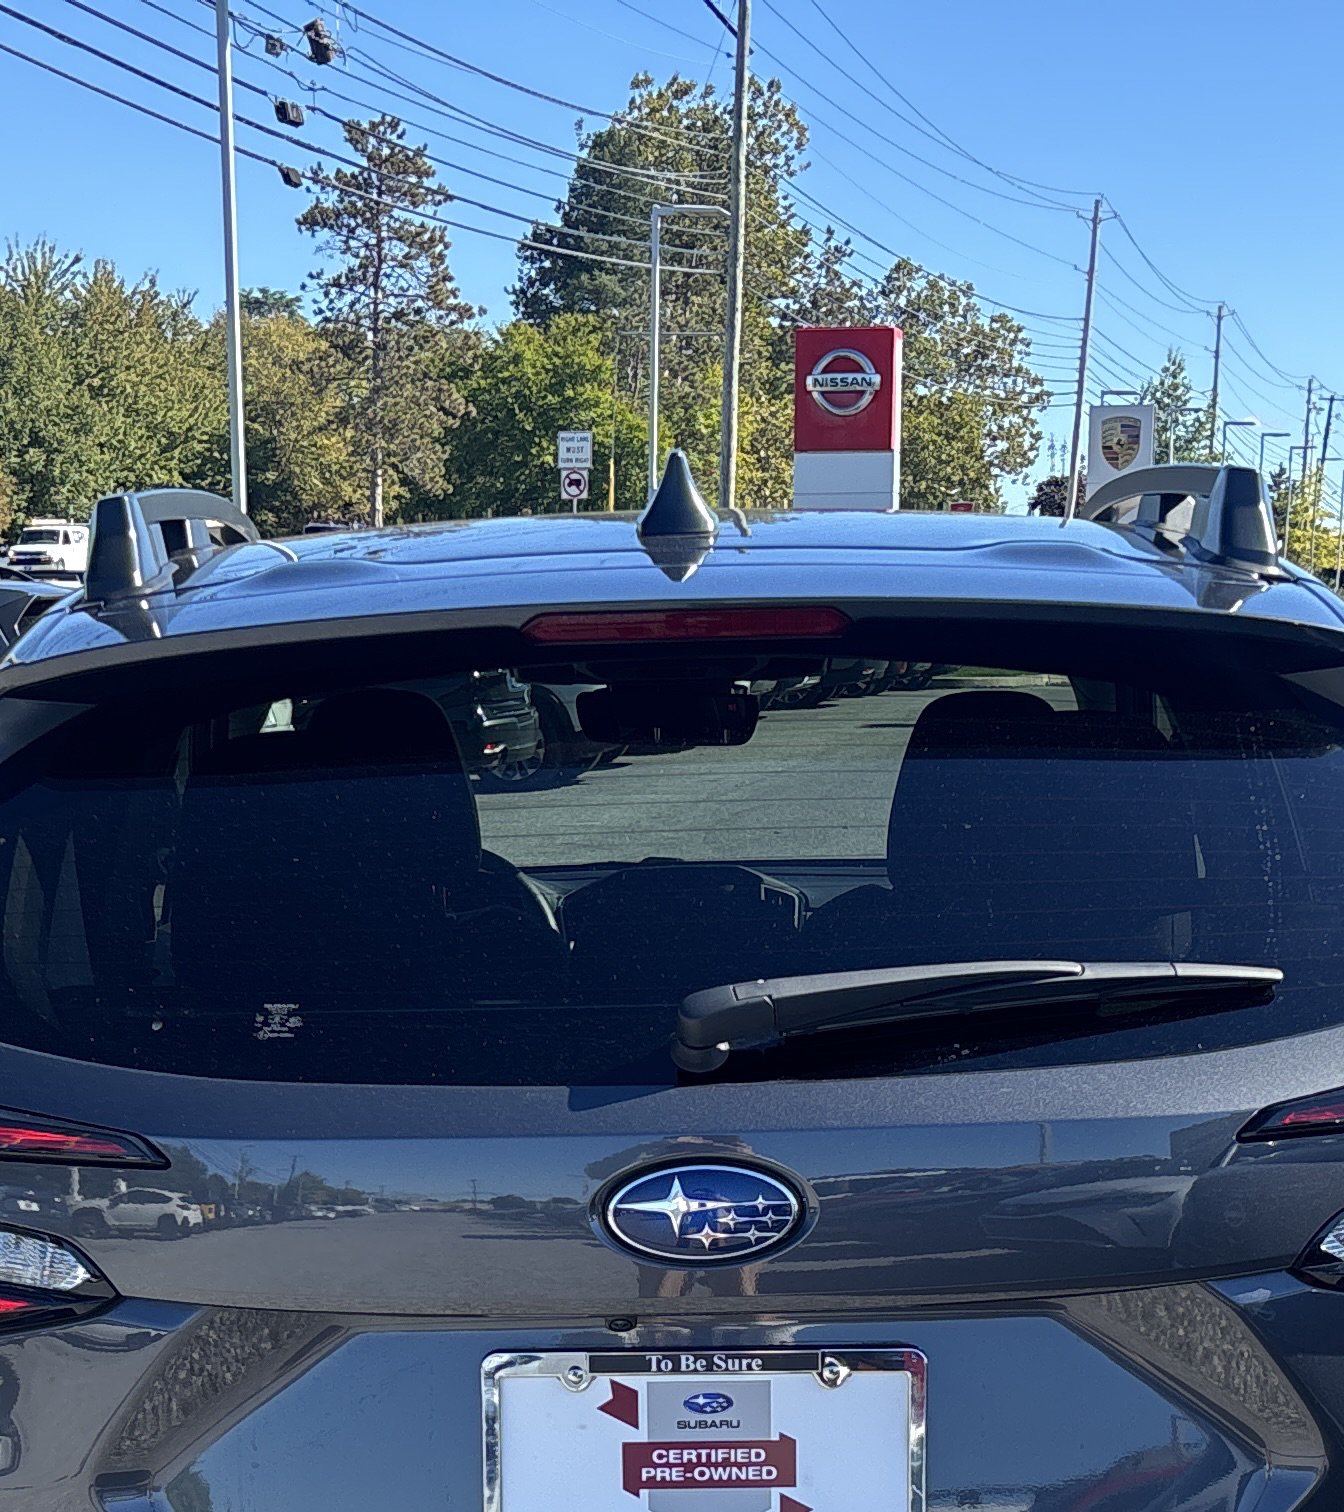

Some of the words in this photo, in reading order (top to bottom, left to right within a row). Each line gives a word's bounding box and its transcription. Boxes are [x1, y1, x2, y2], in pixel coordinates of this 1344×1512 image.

[813, 376, 872, 388] NISSAN
[645, 1354, 672, 1372] To
[680, 1354, 707, 1372] Be
[712, 1354, 763, 1372] Sure
[676, 1418, 741, 1430] SUBARU
[651, 1448, 766, 1464] CERTIFIED
[641, 1465, 778, 1482] PRE-OWNED
